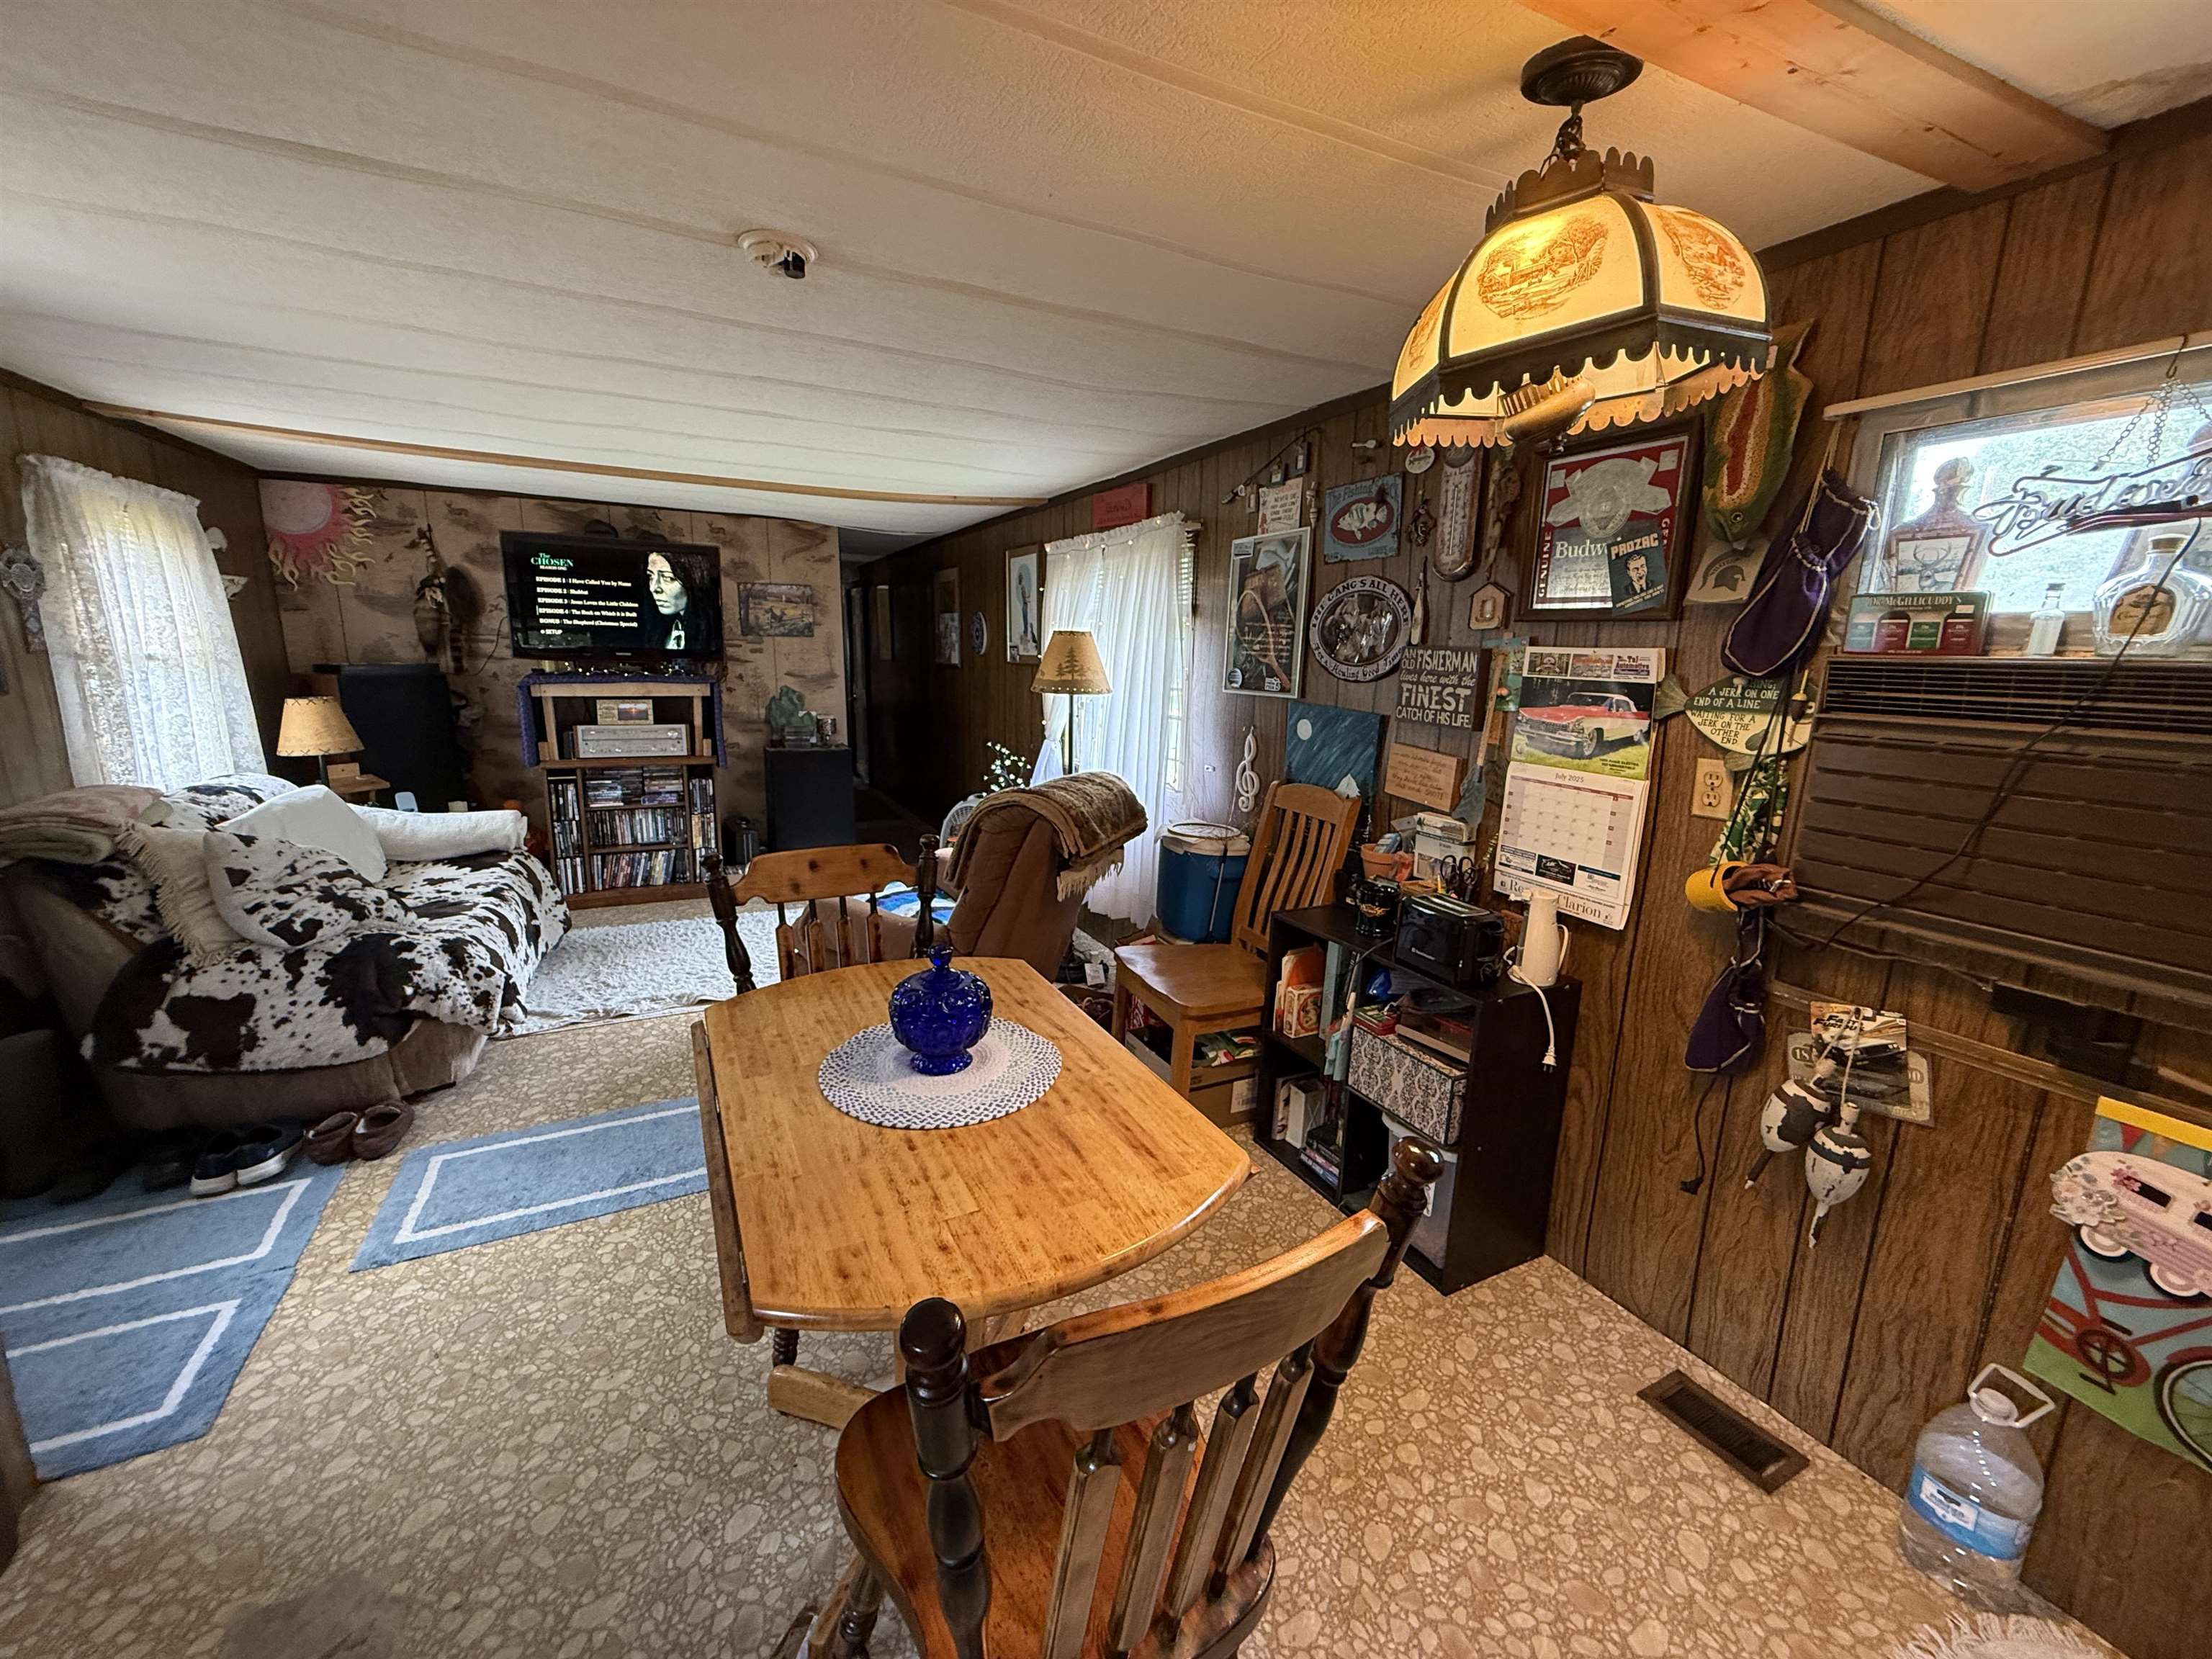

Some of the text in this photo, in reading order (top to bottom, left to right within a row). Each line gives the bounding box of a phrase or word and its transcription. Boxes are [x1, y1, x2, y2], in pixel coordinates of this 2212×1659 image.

[1554, 539, 1609, 559] Budw
[531, 557, 574, 567] CHOSEN
[1539, 531, 1552, 598] GENUINE
[1327, 579, 1367, 602] GANG'S
[1369, 579, 1389, 593] ALL
[1390, 589, 1408, 623] HERE
[1403, 648, 1416, 658] AN
[1401, 659, 1416, 669] OLD
[1416, 649, 1478, 674] FISHERMAN
[1400, 670, 1477, 686] lives here with the
[1401, 683, 1472, 713] FINEST
[1708, 686, 1780, 700] A JERK ON ONE
[1694, 696, 1761, 709] END OF A LINE
[1396, 706, 1423, 721] CATCH
[1424, 709, 1436, 723] OF
[1437, 711, 1450, 726] HIS
[1690, 709, 1755, 724] WAITING FOR A
[1698, 719, 1751, 732] JERK ON THE
[1710, 728, 1740, 738] OTHER
[1721, 737, 1737, 745] END
[1557, 894, 1601, 920] Clarion
